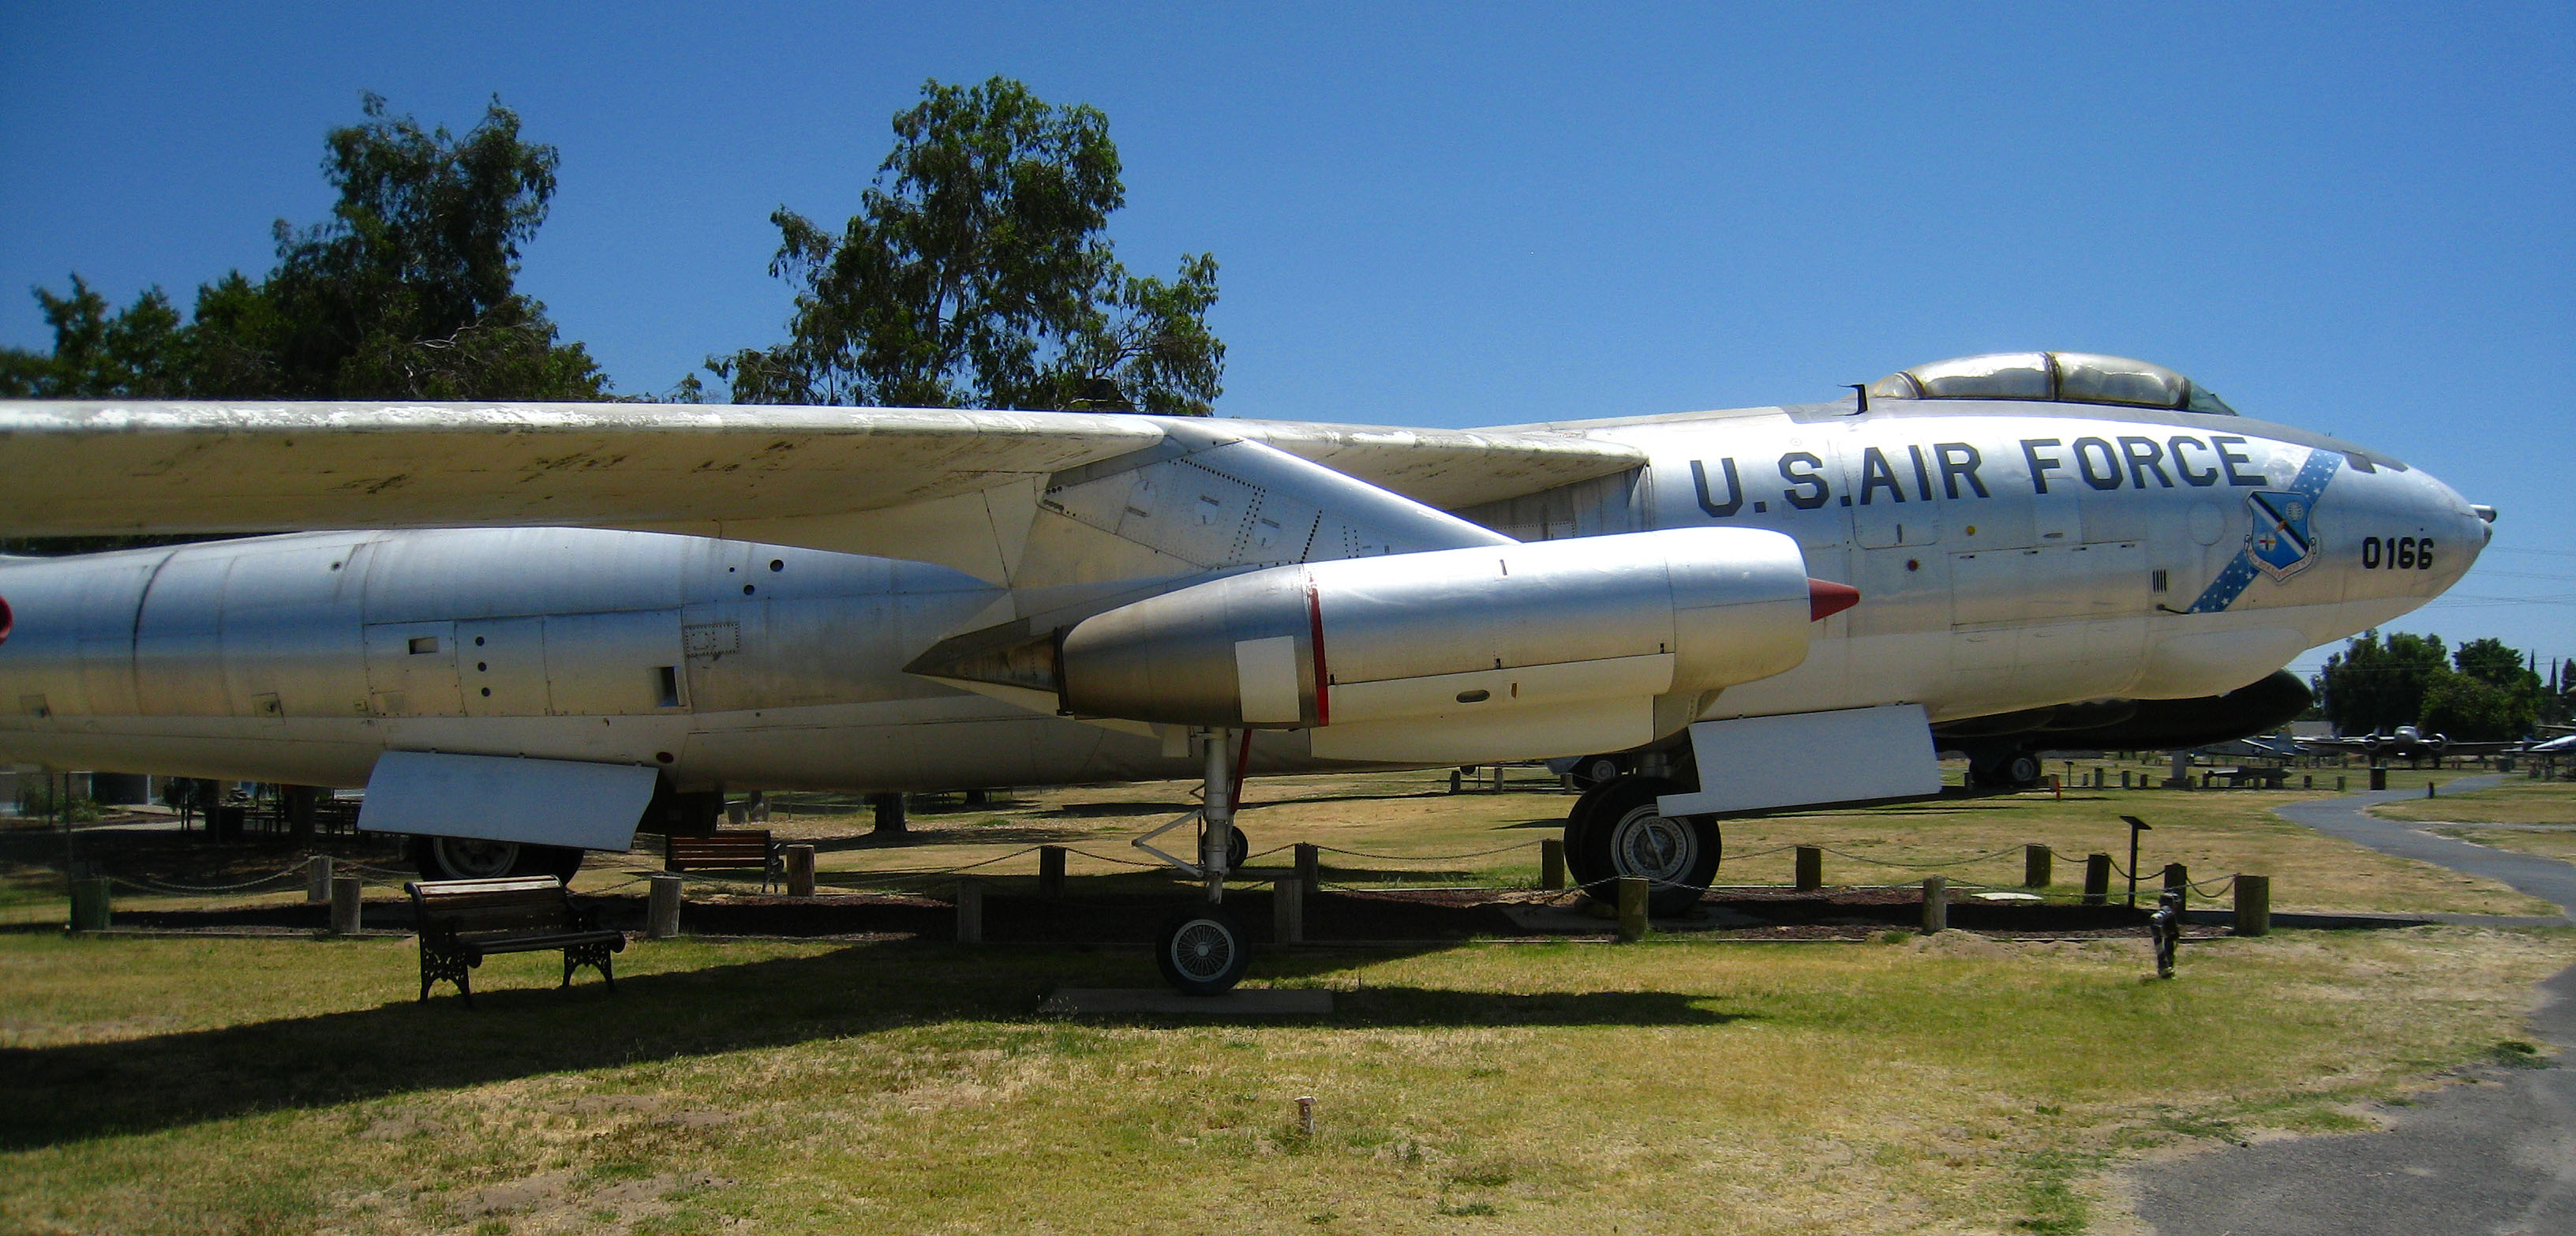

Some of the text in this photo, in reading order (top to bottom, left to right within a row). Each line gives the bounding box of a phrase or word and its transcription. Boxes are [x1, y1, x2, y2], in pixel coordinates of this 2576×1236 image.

[1860, 442, 1990, 505] AIR
[2019, 436, 2267, 495] FORCE
[2362, 537, 2434, 570] 0166
